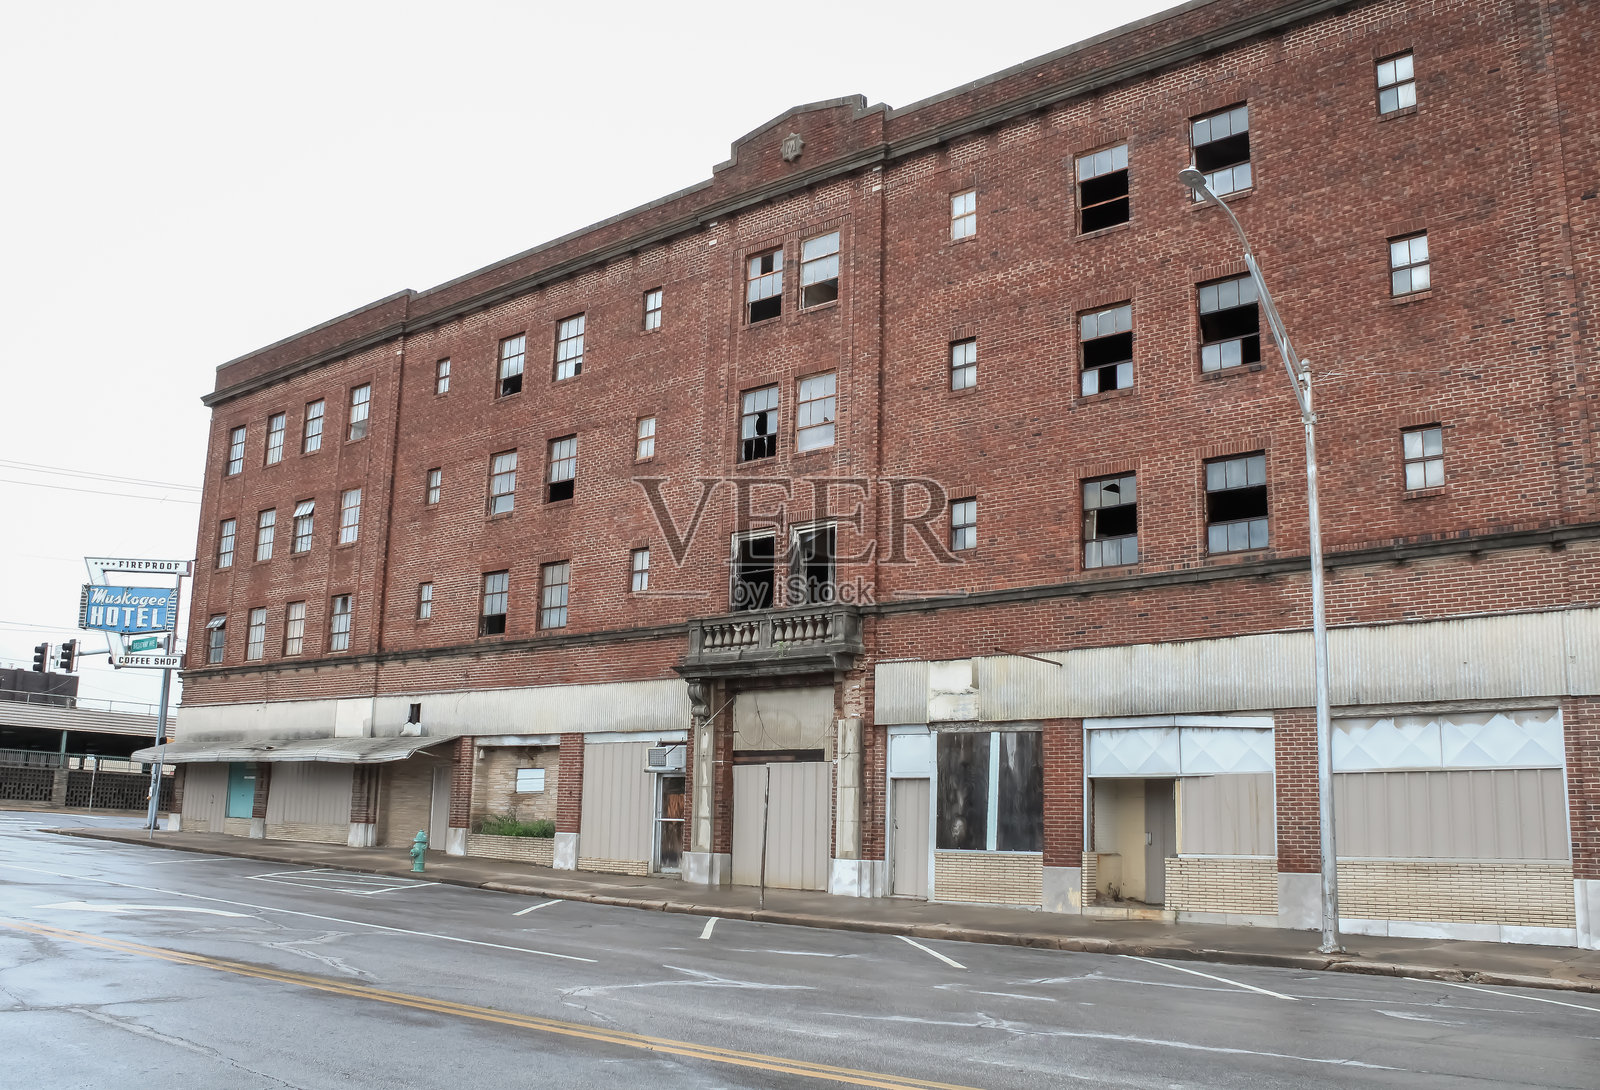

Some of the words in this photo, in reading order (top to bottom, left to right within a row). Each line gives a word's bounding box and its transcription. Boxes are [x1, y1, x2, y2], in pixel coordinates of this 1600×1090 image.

[118, 561, 180, 570] FIREPROOF
[90, 588, 166, 607] Muskogee
[90, 605, 162, 627] HOTEL
[118, 656, 150, 665] COFFEE
[154, 657, 177, 666] SHOP
